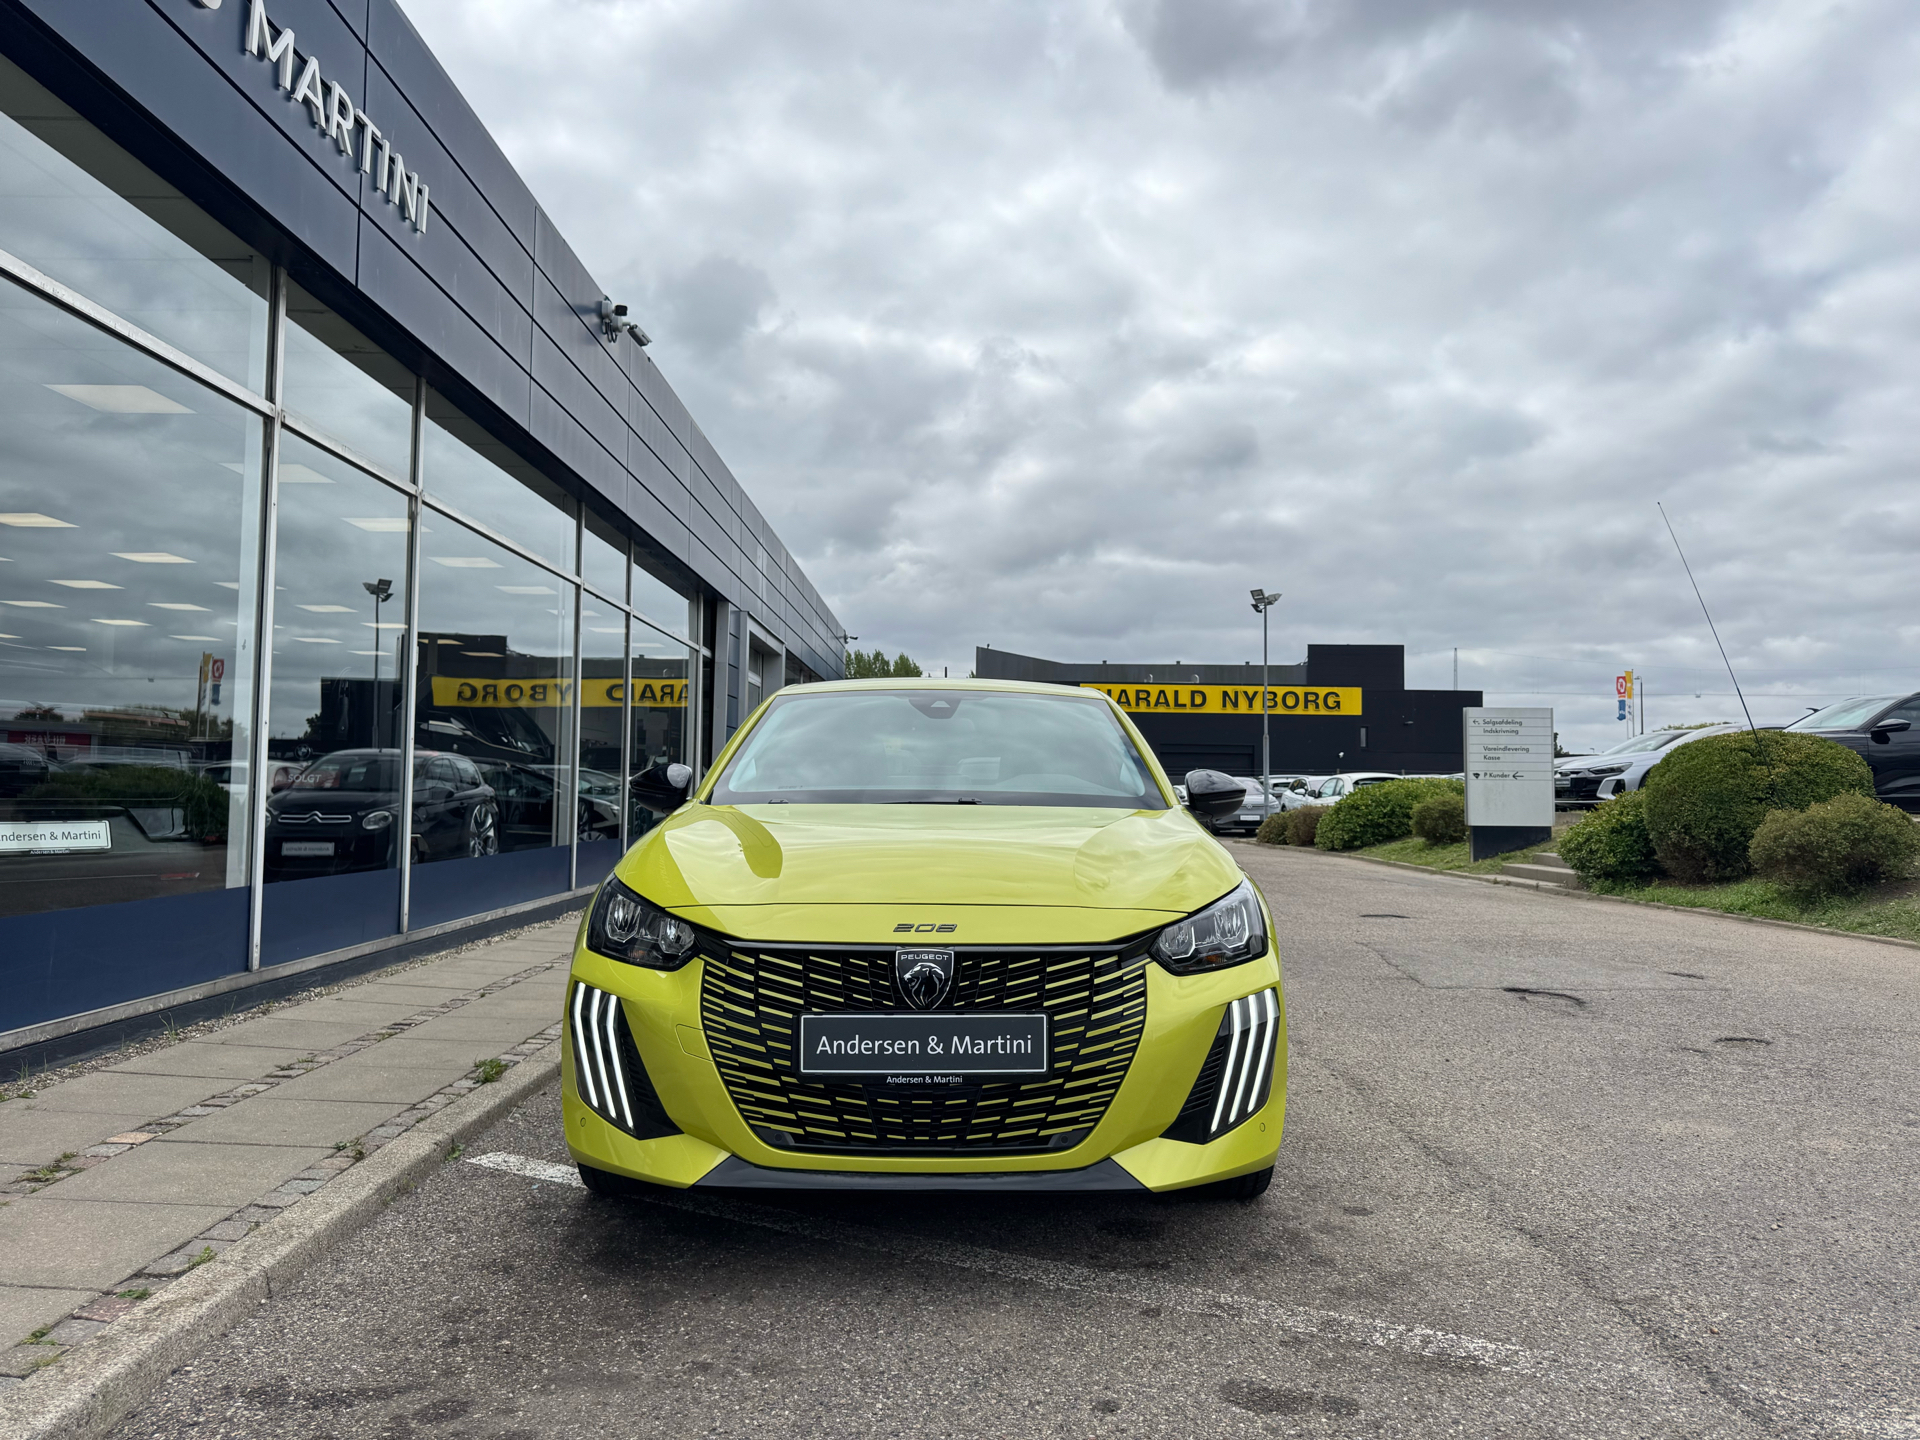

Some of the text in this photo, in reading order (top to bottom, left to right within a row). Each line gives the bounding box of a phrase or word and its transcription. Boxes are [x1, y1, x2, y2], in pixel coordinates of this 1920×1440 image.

[245, 0, 429, 234] MARTINI
[1221, 690, 1341, 711] NYBORG
[1482, 718, 1523, 727] Salgsafdeling
[1483, 727, 1519, 735] Indskrivning
[1483, 745, 1530, 753] Vareindlevering
[288, 774, 322, 783] SOLGT
[0, 830, 101, 842] ndersen & Martini
[893, 923, 958, 933] 208
[900, 953, 950, 961] PEUGEOT
[816, 1034, 1032, 1055] Andersen & Martini
[886, 1075, 963, 1084] Andersen & Martini
